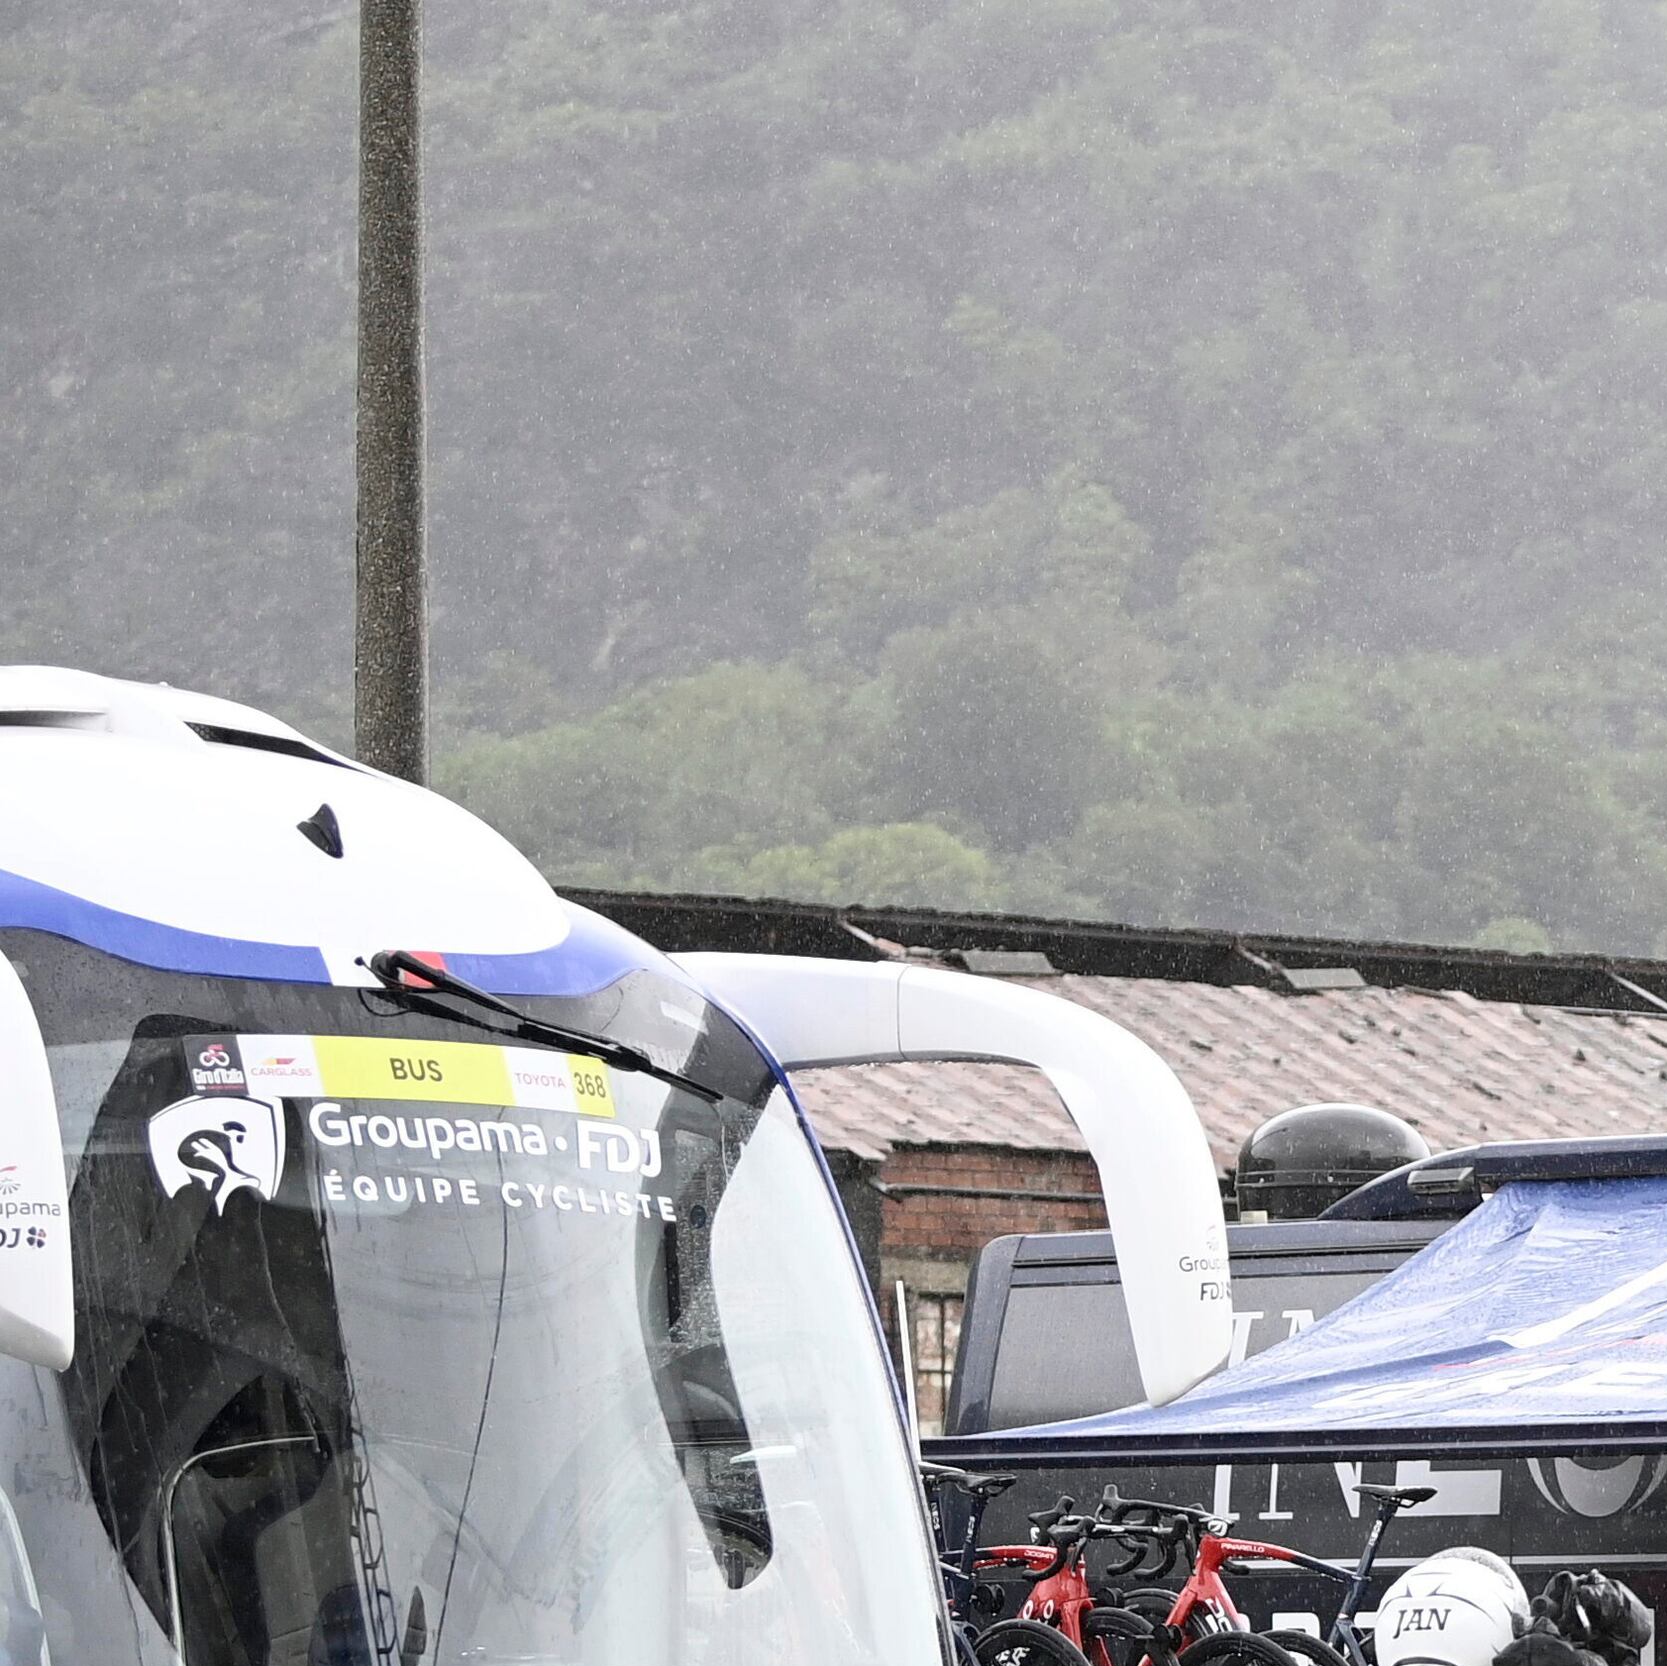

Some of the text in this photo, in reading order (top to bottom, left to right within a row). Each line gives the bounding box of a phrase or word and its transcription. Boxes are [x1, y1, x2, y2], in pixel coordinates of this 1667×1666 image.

[250, 1066, 313, 1077] CARGLASS
[390, 1058, 444, 1082] BUS
[516, 1072, 567, 1089] TOYOTA
[574, 1072, 607, 1099] 368
[308, 1102, 663, 1178] Groupama FDJ
[324, 1169, 677, 1222] ÉQUIPE CYCLISTE
[0, 1201, 61, 1219] pama
[1392, 1608, 1452, 1640] JAN
